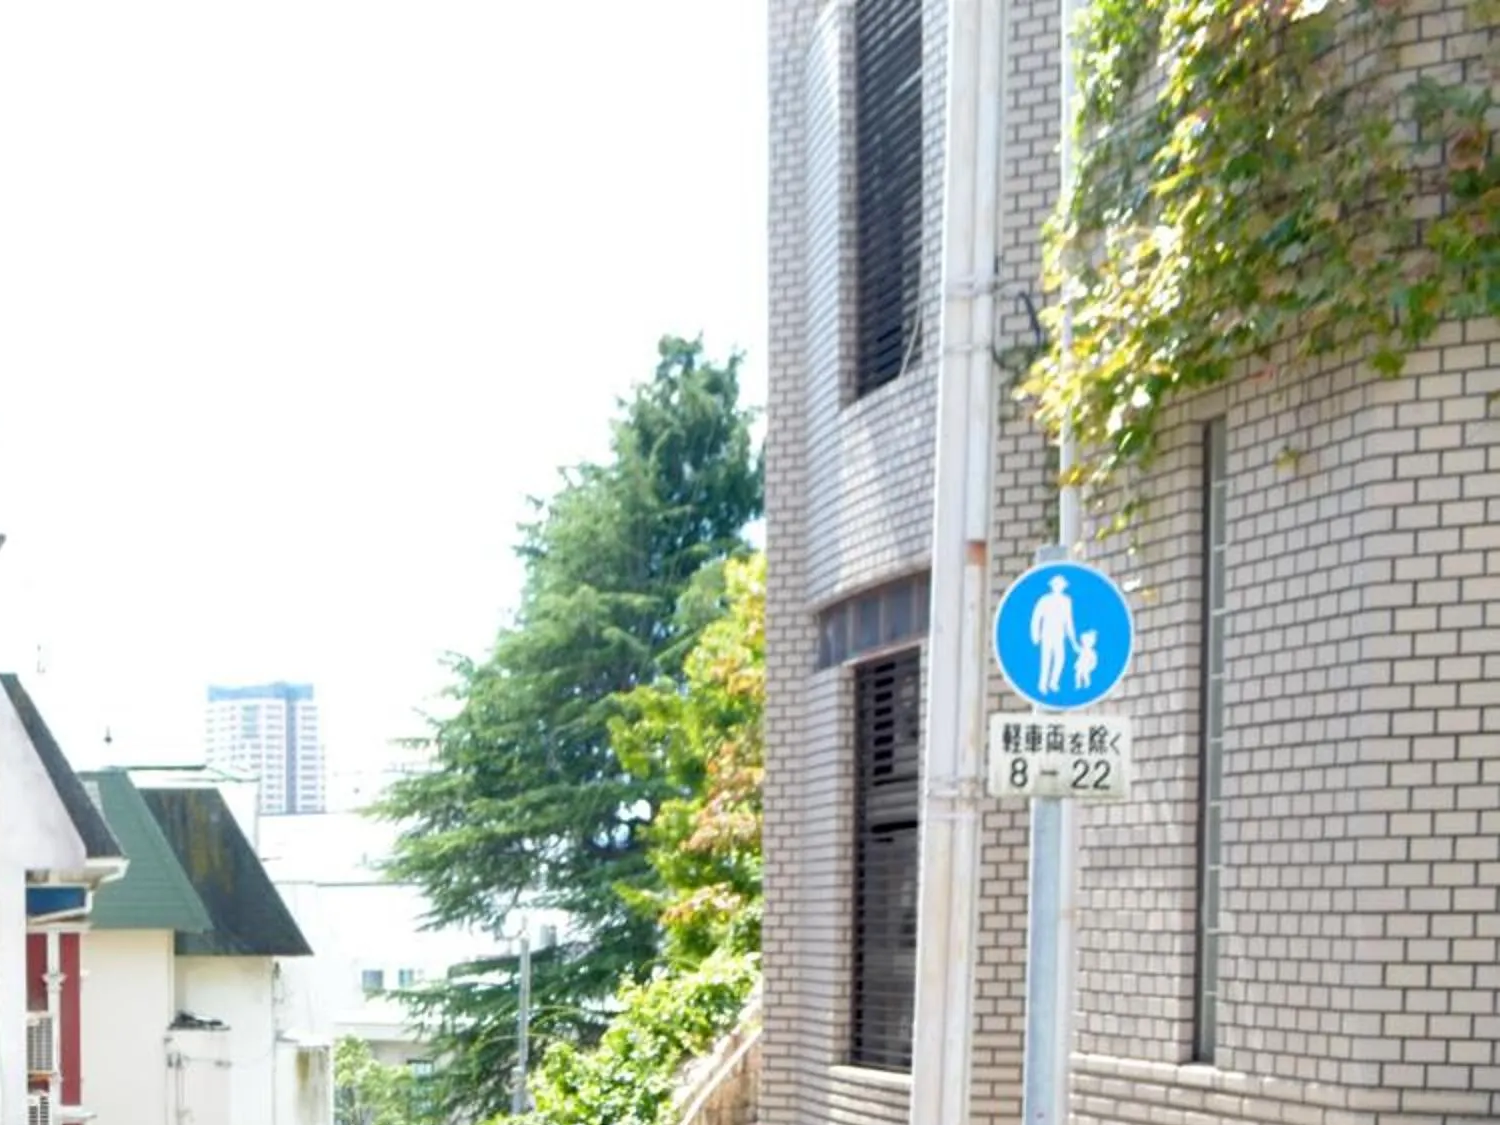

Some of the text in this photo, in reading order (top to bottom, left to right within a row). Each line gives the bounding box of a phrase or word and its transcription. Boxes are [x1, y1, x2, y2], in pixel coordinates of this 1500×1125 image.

[1002, 722, 1122, 756] 軽車両を除く
